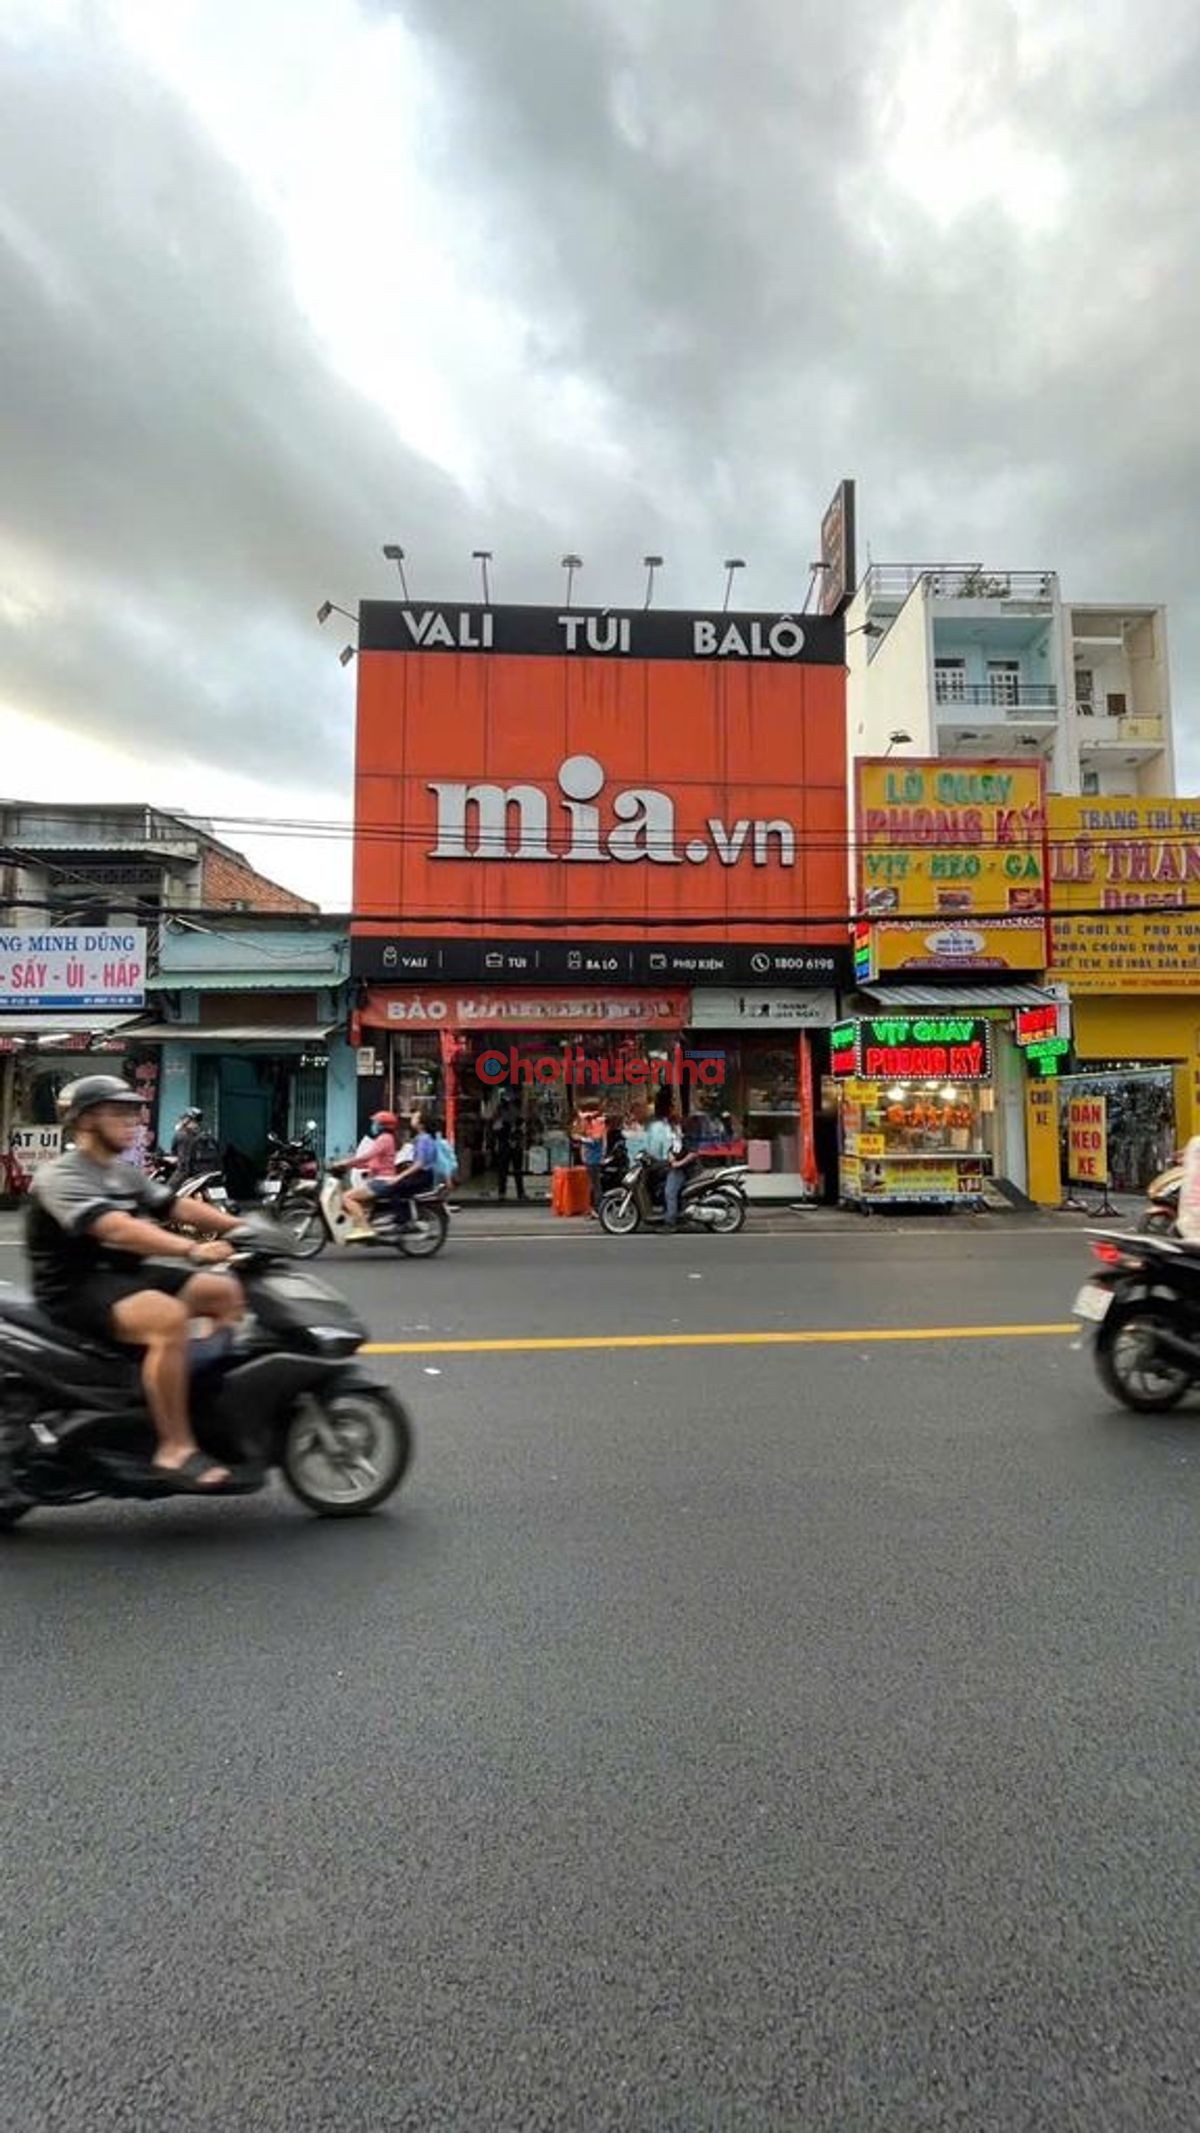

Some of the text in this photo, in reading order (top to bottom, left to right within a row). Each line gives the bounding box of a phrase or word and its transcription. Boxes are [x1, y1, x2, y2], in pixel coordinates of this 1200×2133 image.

[402, 606, 805, 657] VALI TÚI BALÔ
[427, 755, 796, 868] mia.vn
[866, 808, 983, 846] PHONG
[867, 854, 908, 884] VỊT
[930, 854, 981, 879] HEO
[1050, 832, 1096, 884] LÊ
[28, 935, 78, 952] MINH
[85, 931, 135, 952] DŨNG
[11, 954, 48, 989] SẤY
[66, 955, 85, 988] ỦI
[103, 954, 140, 988] HẤP
[401, 956, 428, 968] VALI
[774, 957, 804, 970] 1800
[387, 995, 448, 1020] BẢO
[872, 1021, 909, 1046] VỊT
[912, 1021, 974, 1042] QUAY
[866, 1047, 946, 1074] PHONG
